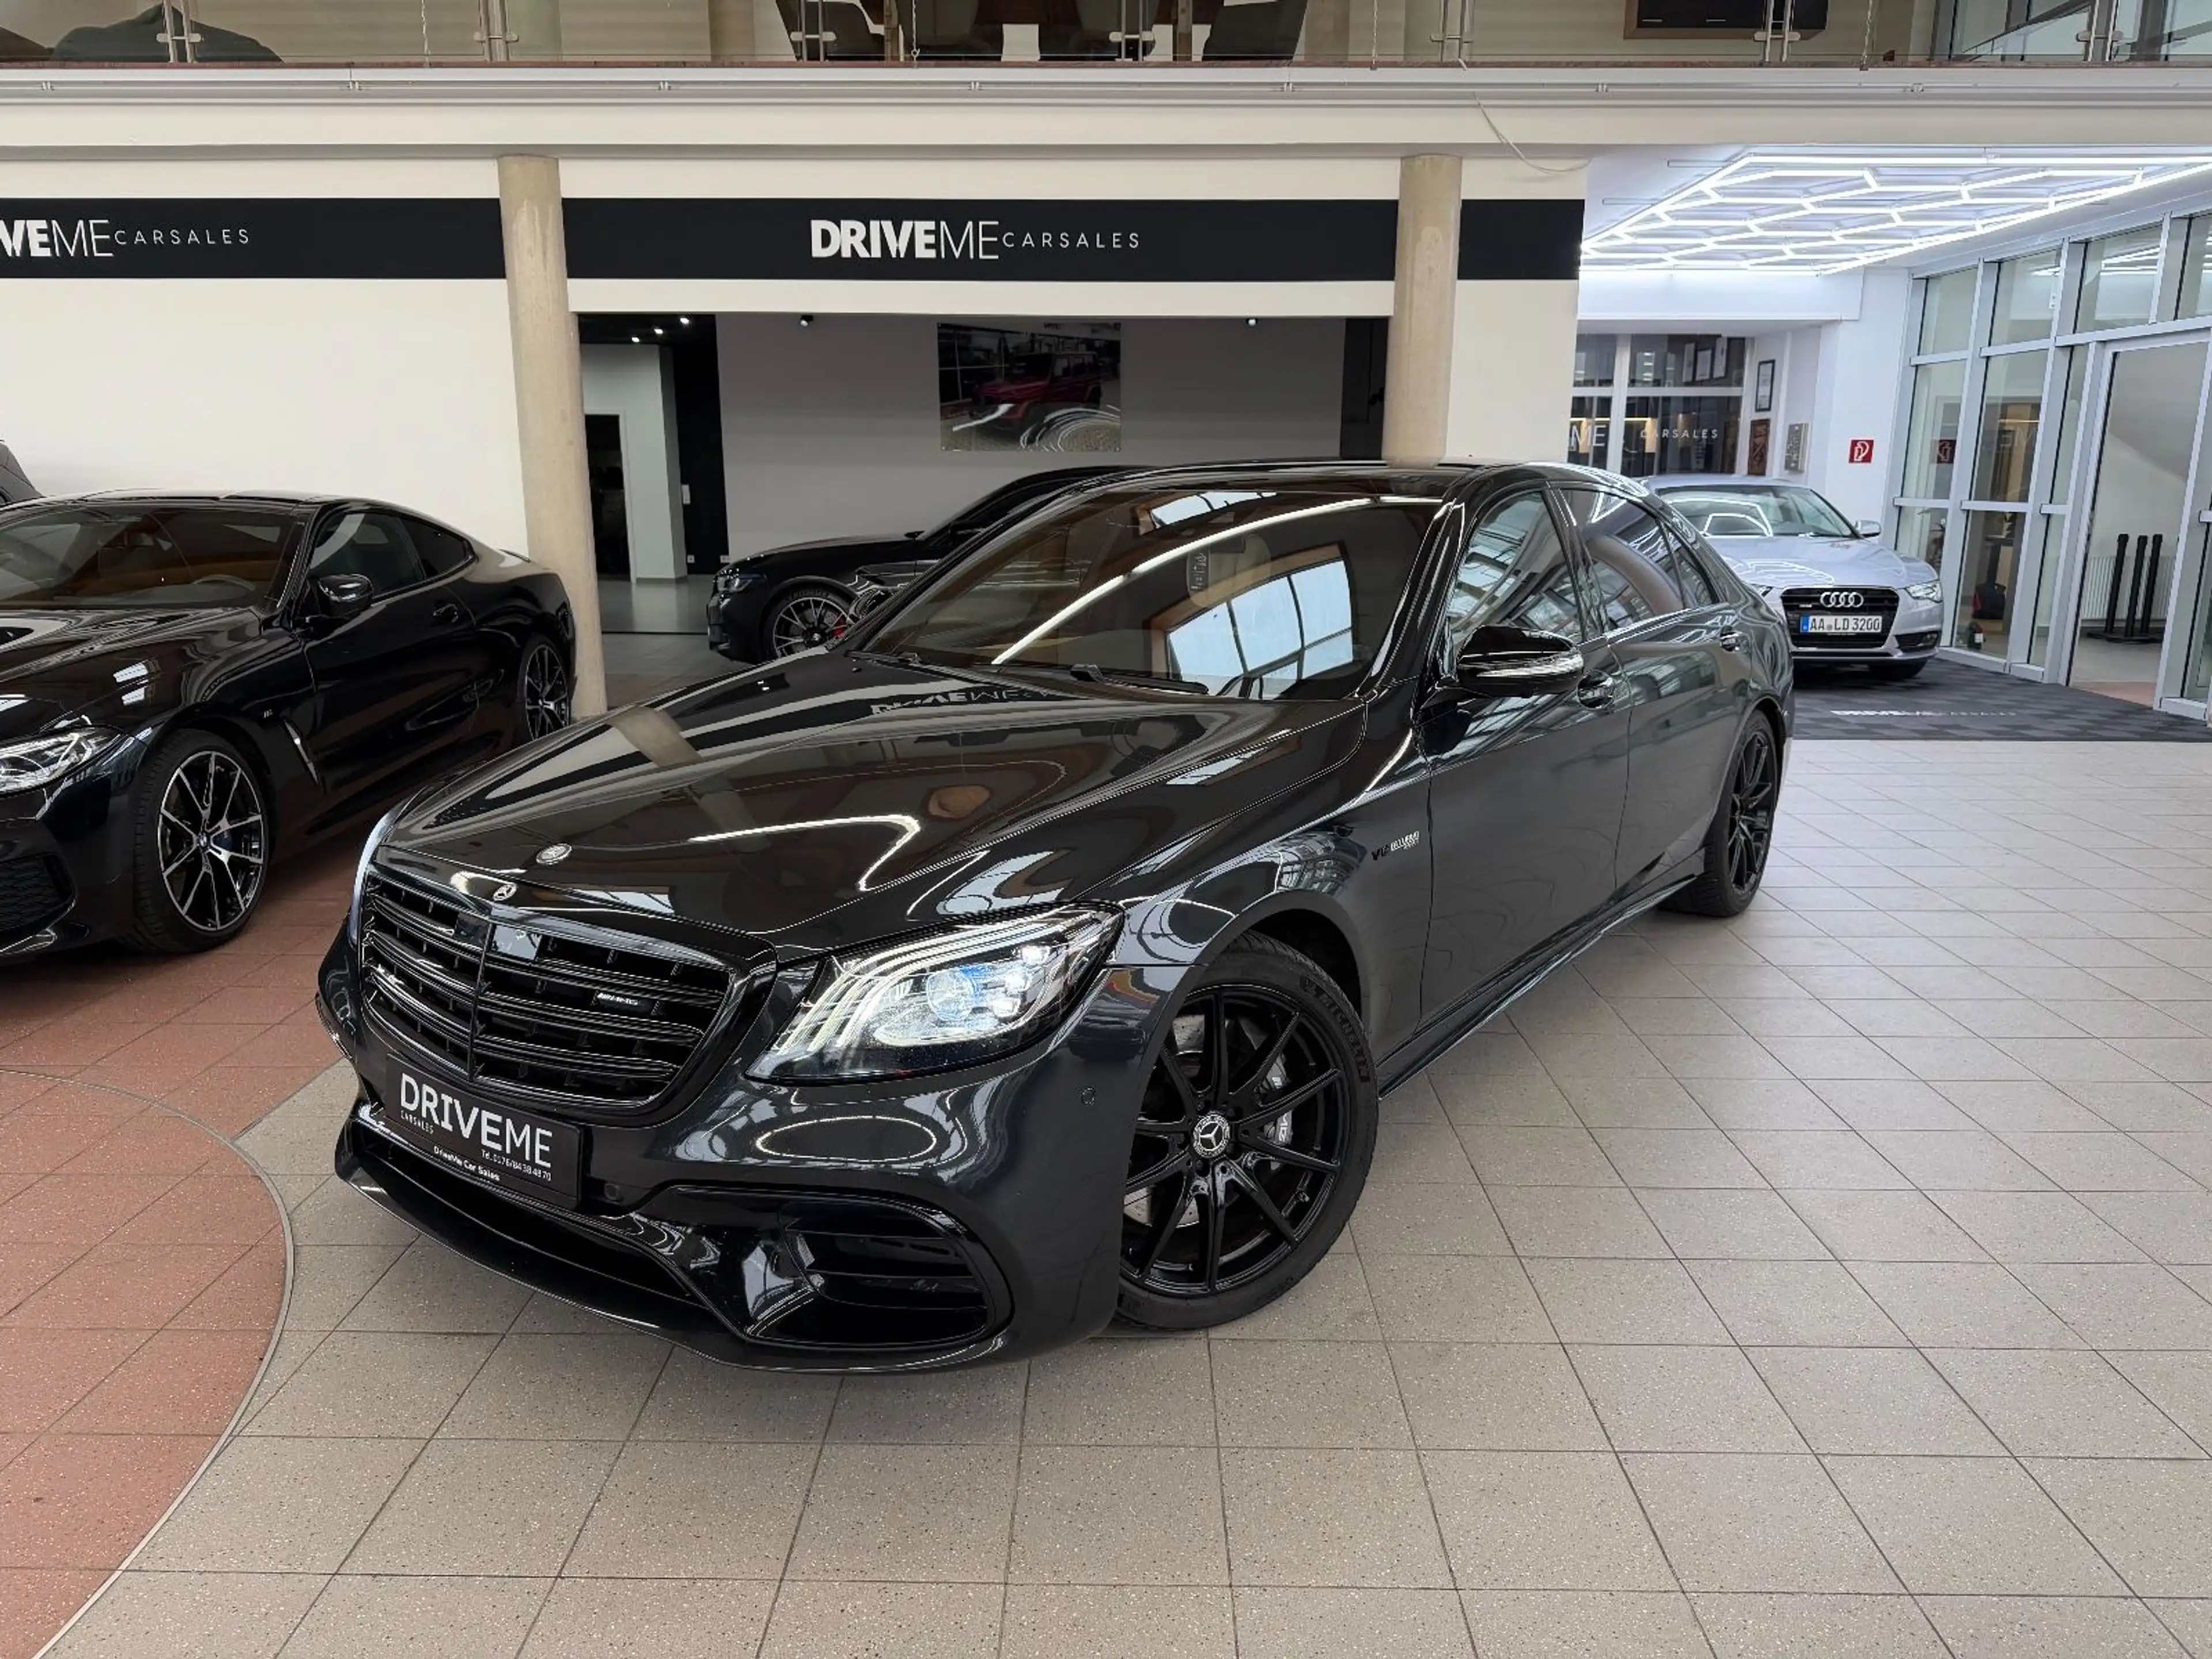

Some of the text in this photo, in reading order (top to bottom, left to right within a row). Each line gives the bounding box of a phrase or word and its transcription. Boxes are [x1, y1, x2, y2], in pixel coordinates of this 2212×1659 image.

[810, 219, 1140, 260] DRIVEME CARSALES
[1810, 618, 1825, 631] AA
[400, 1073, 553, 1169] DRIVEME
